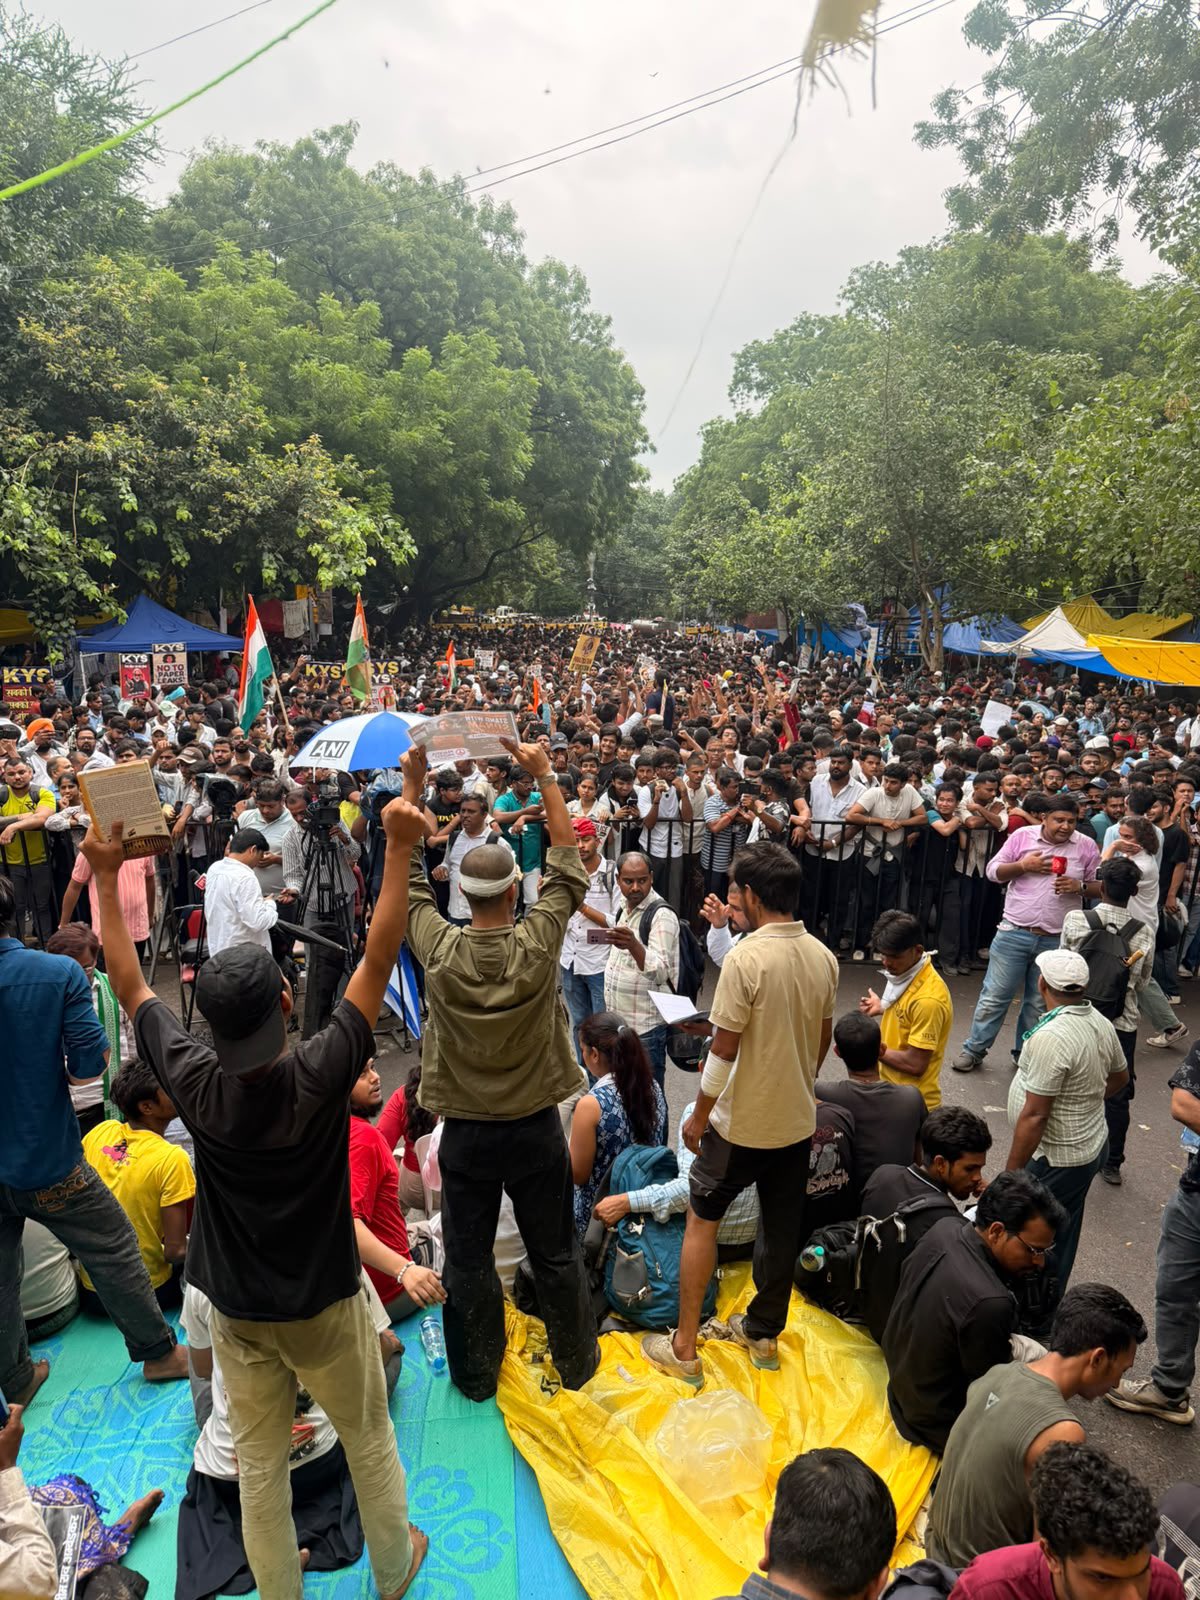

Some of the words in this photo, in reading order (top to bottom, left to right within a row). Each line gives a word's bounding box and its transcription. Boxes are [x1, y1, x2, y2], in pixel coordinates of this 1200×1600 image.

[154, 643, 184, 652] KYS
[122, 654, 148, 663] KYS
[157, 664, 170, 672] NO
[305, 663, 341, 679] KYS
[3, 667, 50, 683] KYS
[372, 674, 390, 684] YS
[311, 741, 348, 758] ANI
